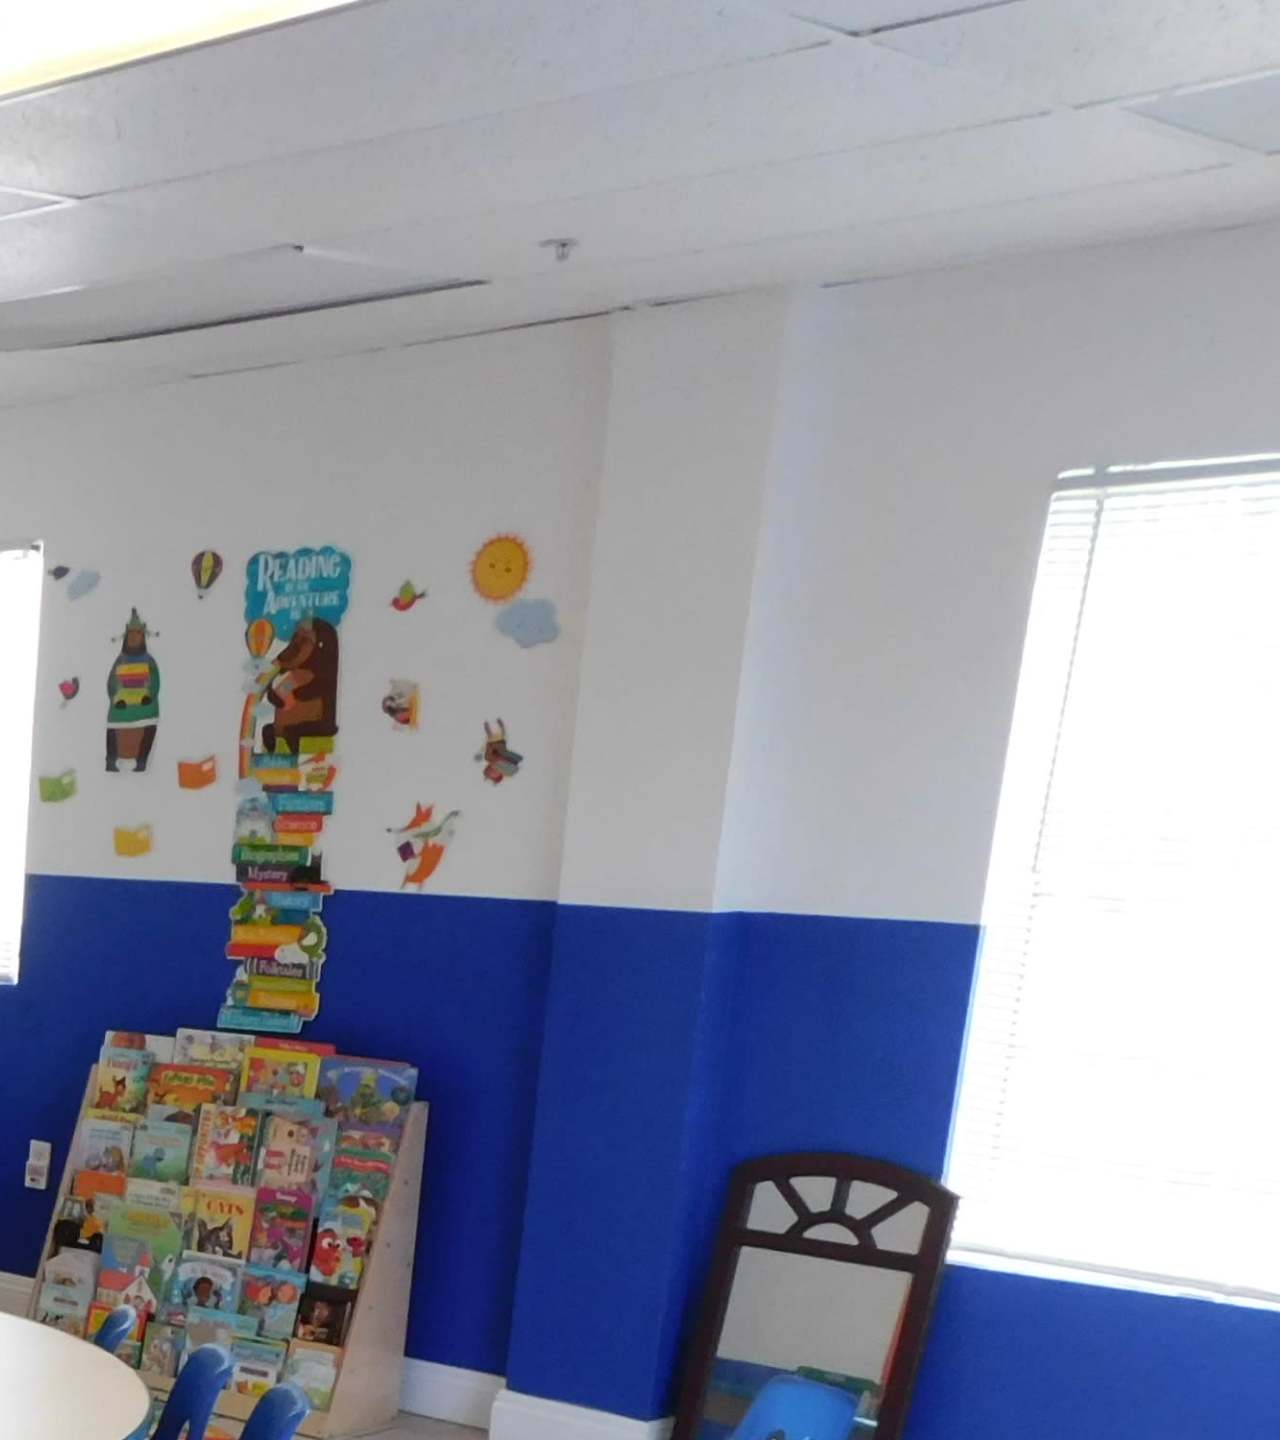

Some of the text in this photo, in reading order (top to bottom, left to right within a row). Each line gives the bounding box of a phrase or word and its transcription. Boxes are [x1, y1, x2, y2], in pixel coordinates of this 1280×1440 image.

[257, 555, 341, 592] READING
[248, 866, 288, 882] Mystery
[206, 1202, 244, 1216] CATS
